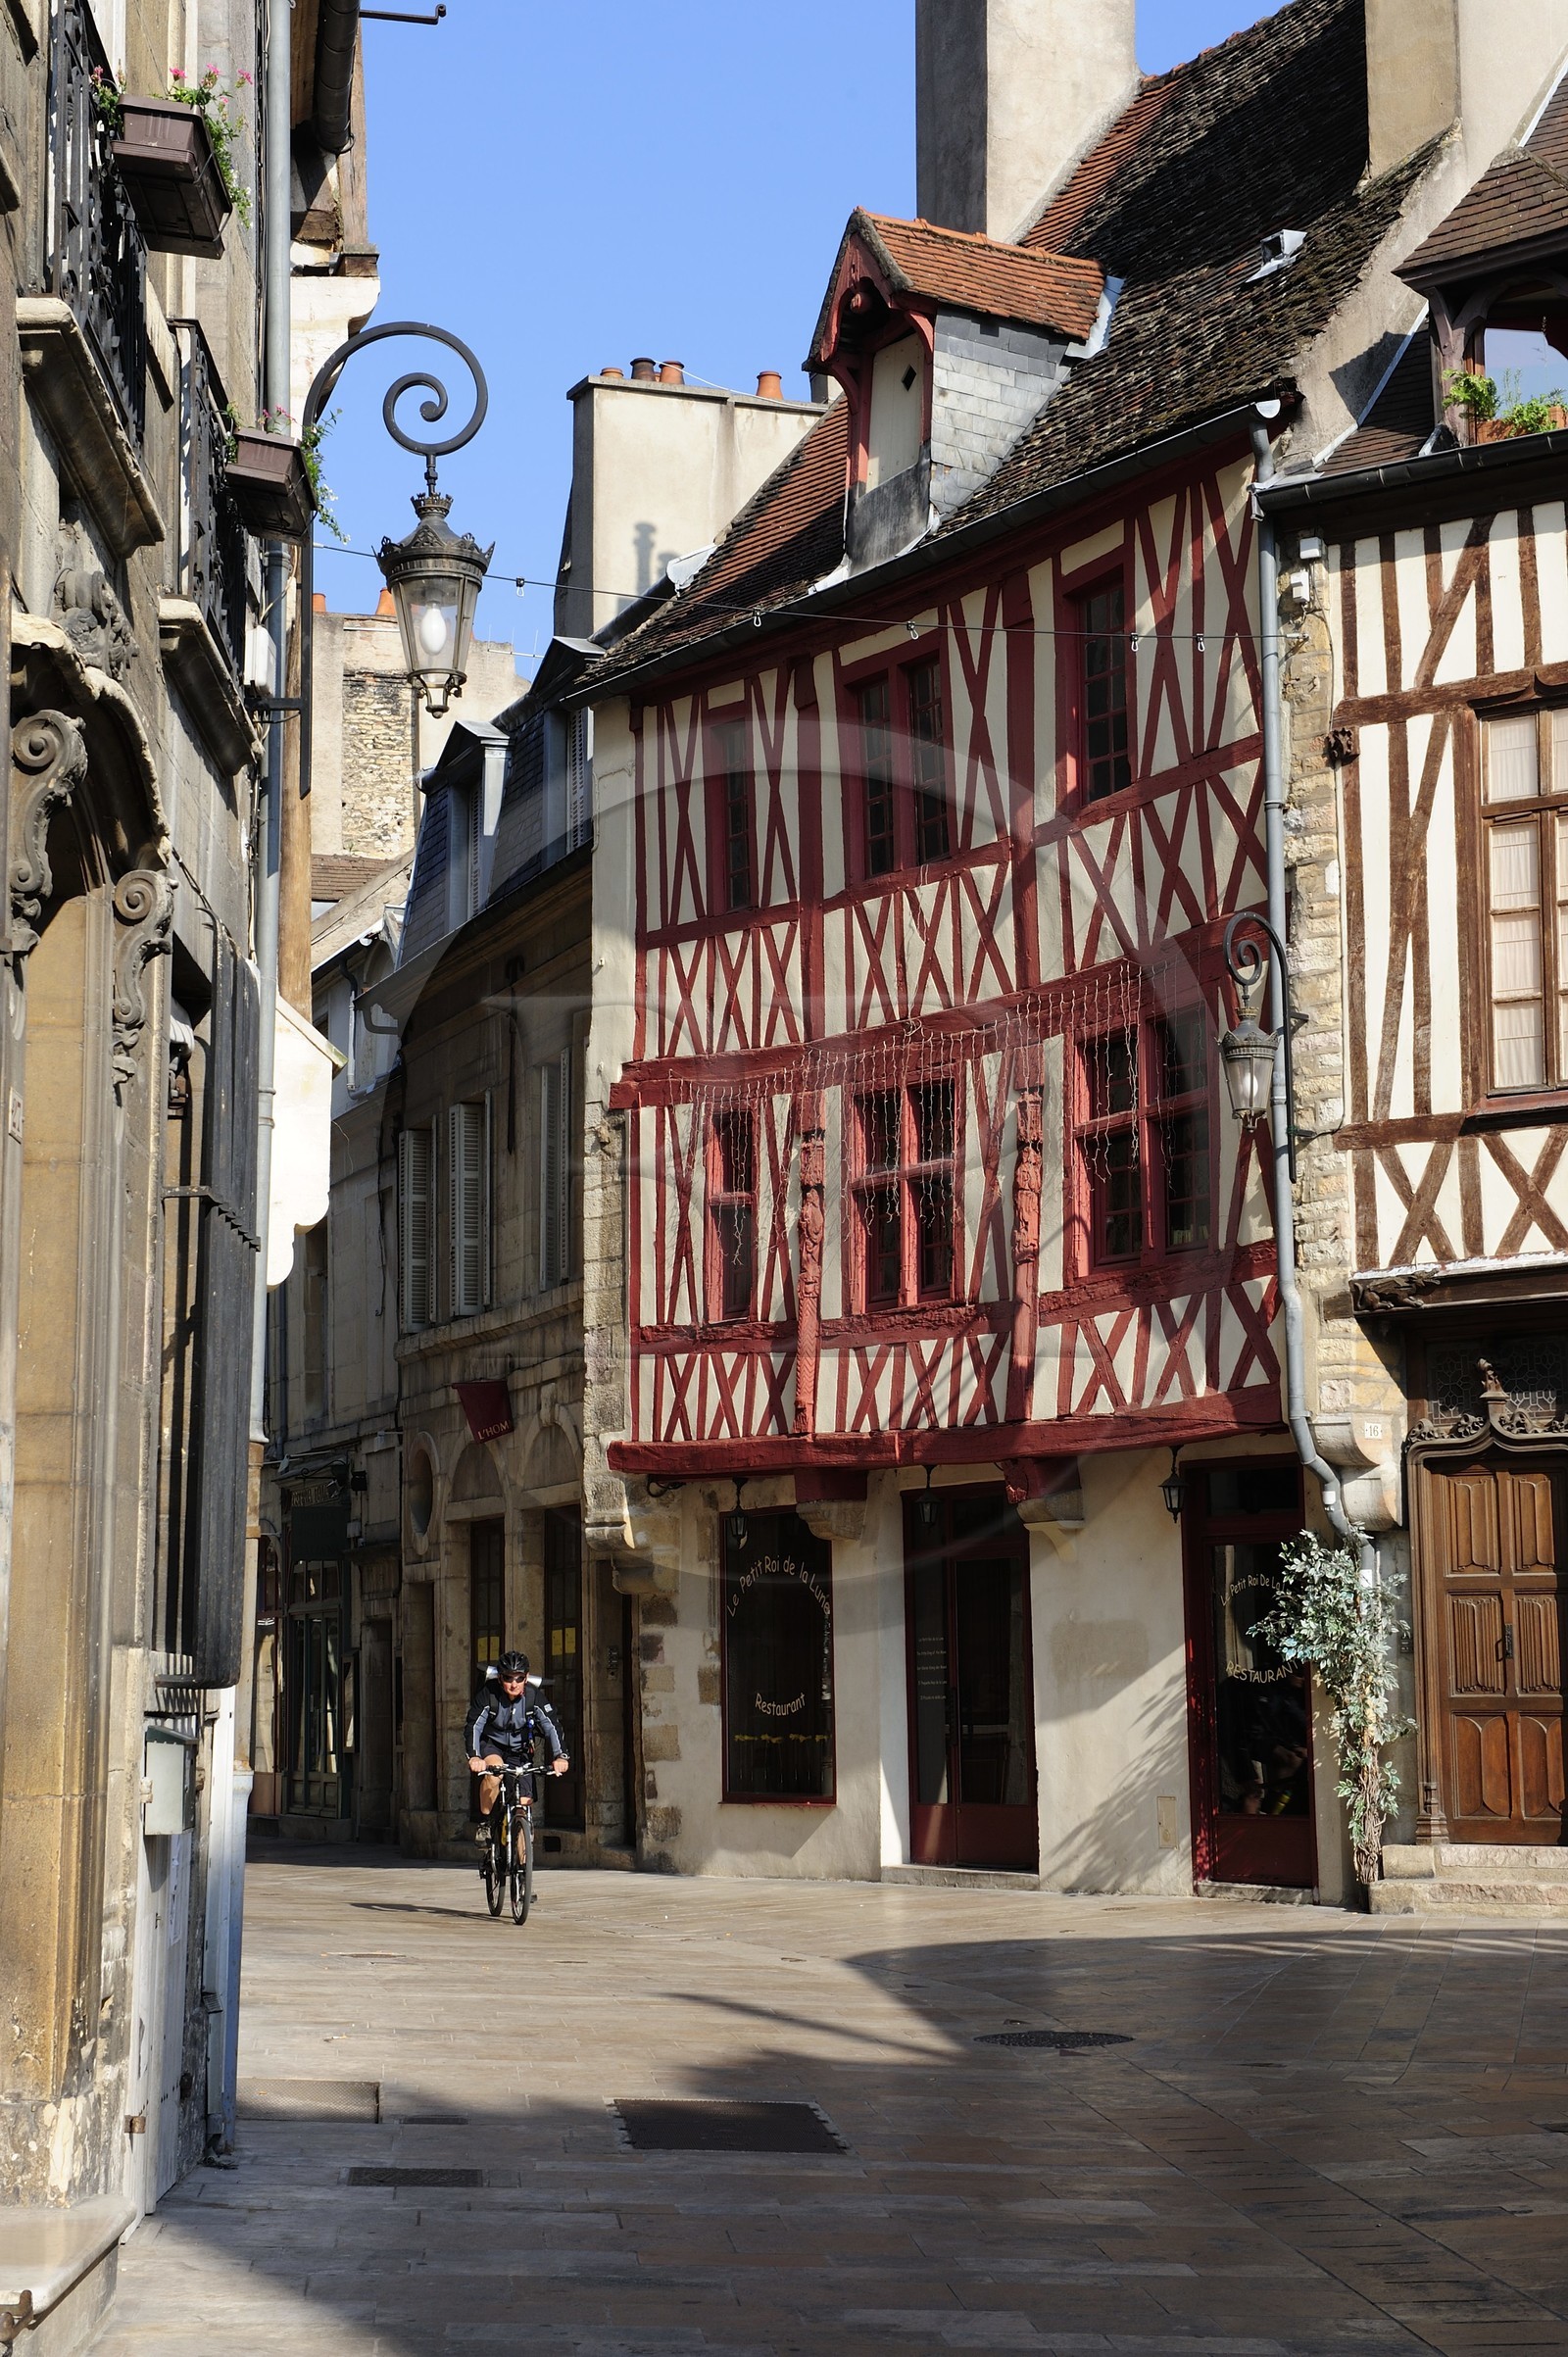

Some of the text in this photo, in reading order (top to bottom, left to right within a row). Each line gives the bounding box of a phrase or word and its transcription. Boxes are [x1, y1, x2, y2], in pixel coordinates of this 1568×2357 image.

[1369, 1425, 1379, 1437] 16
[727, 1554, 830, 1617] Le Petit Roi de la Lune
[1230, 1578, 1247, 1596] Petit
[1249, 1574, 1258, 1586] Roi
[1260, 1574, 1269, 1587] De
[1272, 1576, 1280, 1590] La
[1226, 1660, 1298, 1684] RESTAURANT
[755, 1692, 806, 1716] Restaurant
